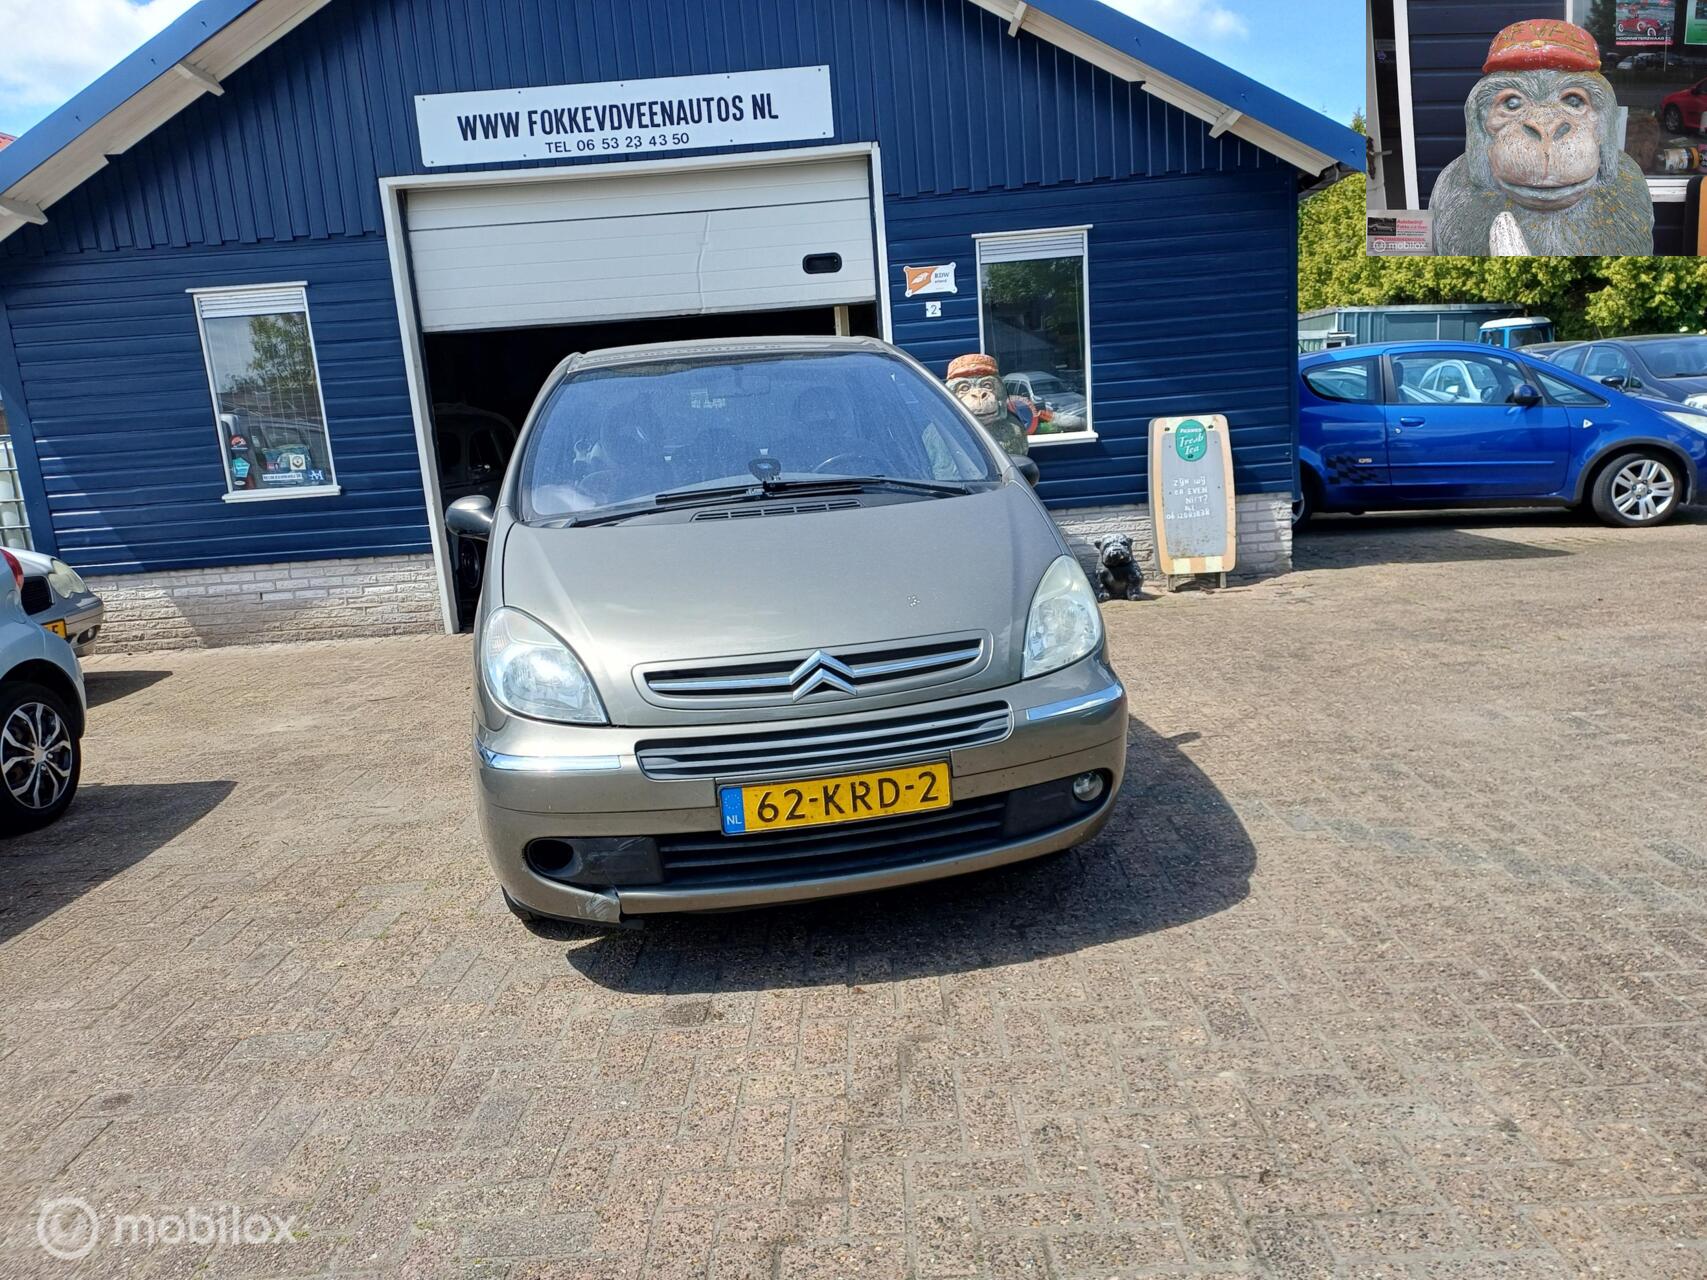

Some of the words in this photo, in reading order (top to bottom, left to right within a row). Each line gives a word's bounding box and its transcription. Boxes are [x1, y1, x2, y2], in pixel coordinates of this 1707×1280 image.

[457, 111, 520, 141] WWW
[527, 94, 744, 136] FOKKEVDVEENAUTOS
[751, 93, 779, 120] NL
[545, 141, 572, 153] TEL
[576, 139, 595, 151] 06
[602, 137, 620, 150] 53
[625, 135, 642, 149] 23
[649, 134, 667, 147] 43
[672, 132, 690, 145] 50
[930, 304, 938, 315] 2
[1184, 445, 1200, 455] Tea
[757, 771, 939, 823] 62-KRD-2
[726, 815, 742, 826] NL
